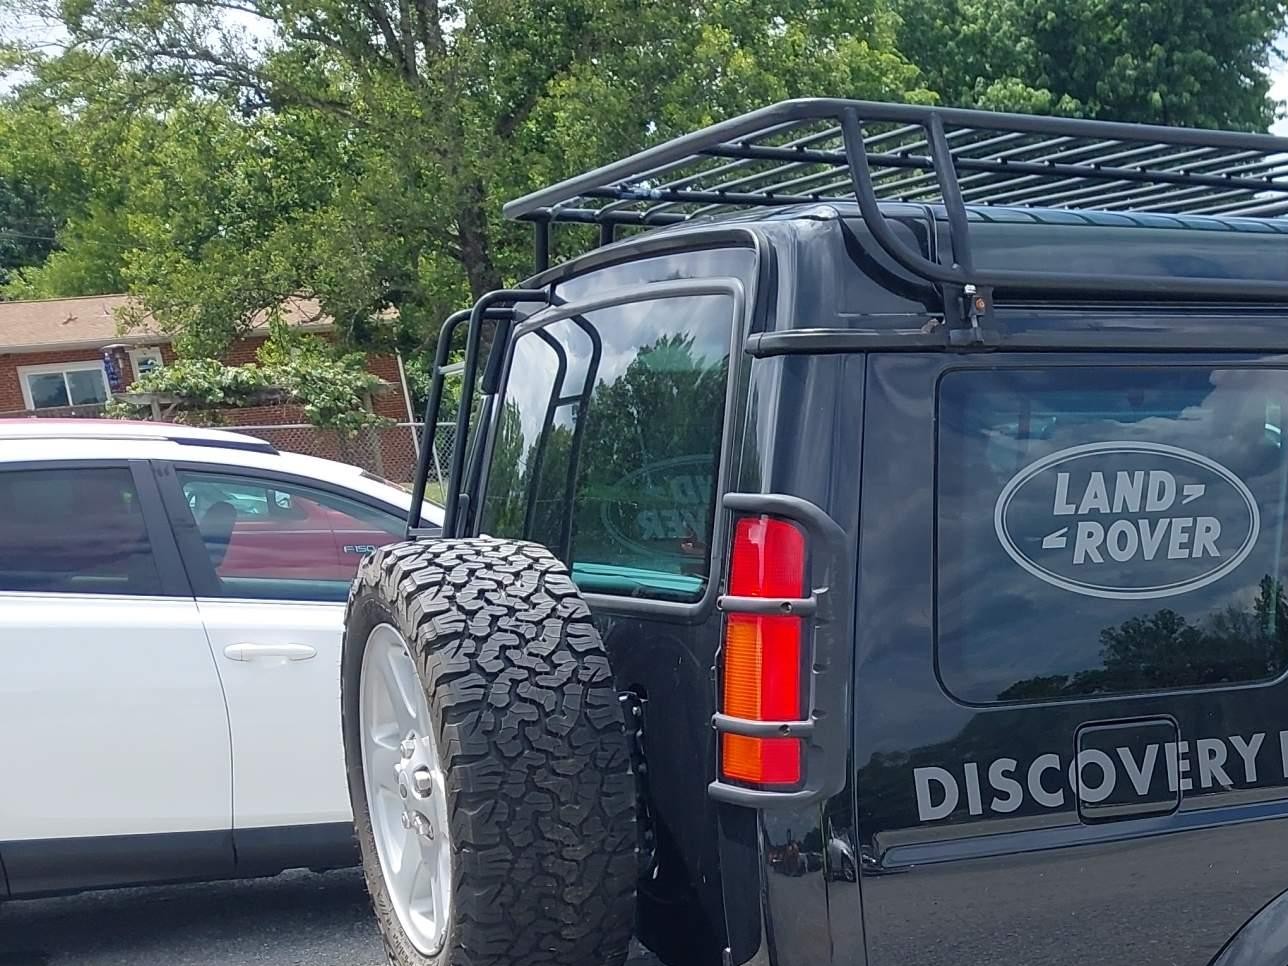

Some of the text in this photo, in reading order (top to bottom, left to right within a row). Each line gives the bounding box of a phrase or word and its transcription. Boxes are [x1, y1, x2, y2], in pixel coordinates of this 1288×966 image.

[1053, 470, 1176, 515] LAND
[1073, 517, 1221, 564] ROVER
[913, 732, 1266, 821] DISCOVERY
